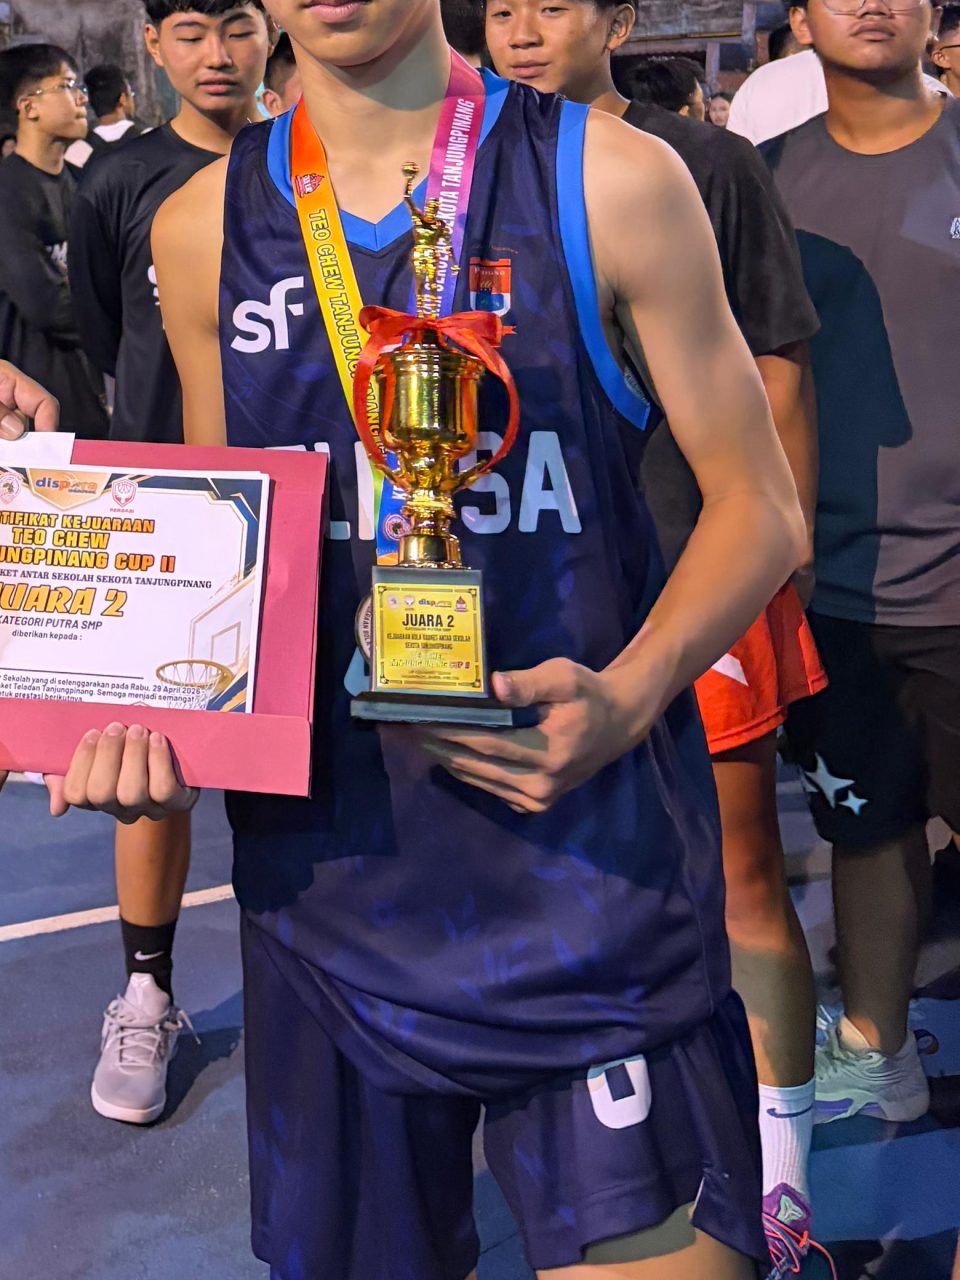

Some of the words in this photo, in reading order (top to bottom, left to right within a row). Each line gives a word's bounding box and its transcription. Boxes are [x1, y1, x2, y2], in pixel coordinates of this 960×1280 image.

[443, 98, 475, 188] TANJUNGPINANG
[309, 209, 330, 241] TEO
[316, 244, 338, 290] CHEW
[328, 293, 382, 437] TANJUNGNANG
[61, 514, 156, 534] KEJUARAAN
[12, 526, 47, 546] TEO
[52, 529, 110, 549] CHEW
[115, 552, 155, 573] CUP
[159, 554, 176, 574] II
[19, 570, 50, 580] ANTAR
[51, 572, 94, 583] SEKOLAH
[96, 574, 132, 585] SEKOTA
[135, 577, 212, 589] TANJUNGPINANG
[100, 588, 128, 617] 2
[45, 617, 79, 629] PUTRA
[81, 619, 103, 631] SMP
[402, 613, 443, 627] JUARA
[447, 615, 455, 628] 2
[12, 629, 48, 639] diberikan
[49, 631, 78, 641] kepada
[3, 674, 31, 682] Sekolah
[31, 677, 49, 685] yang
[57, 679, 110, 689] selenggarakan
[111, 682, 129, 691] pada
[163, 685, 181, 694] April
[13, 683, 41, 691] Teladan
[97, 688, 127, 699] Semoga
[128, 691, 157, 701] menjadi
[158, 694, 195, 703] semangat
